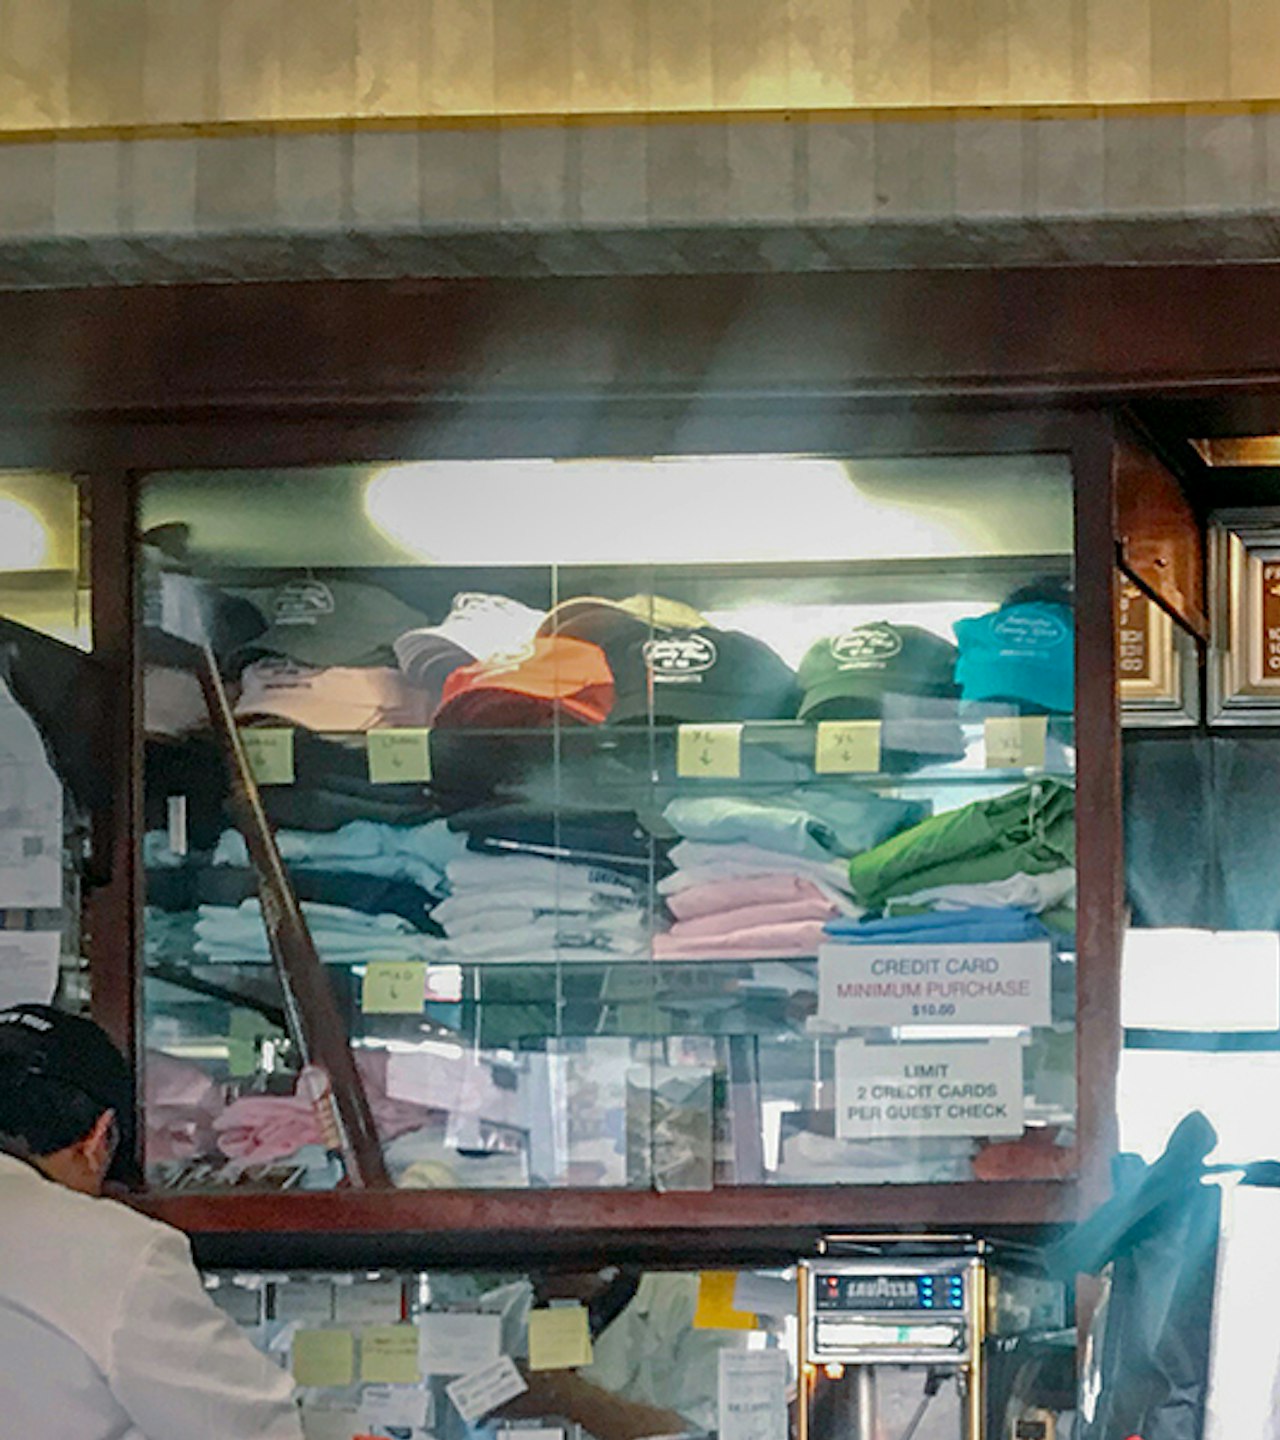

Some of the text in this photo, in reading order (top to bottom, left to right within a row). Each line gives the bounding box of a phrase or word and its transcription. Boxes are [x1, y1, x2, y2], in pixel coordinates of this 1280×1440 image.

[871, 958, 998, 975] CREDIT CARD
[838, 980, 1030, 998] MINIMUM PURCHASE
[905, 1065, 948, 1077] LIMIT
[858, 1085, 997, 1098] 2 CREDIT CARDS
[848, 1104, 1007, 1120] PER GUEST CHECK
